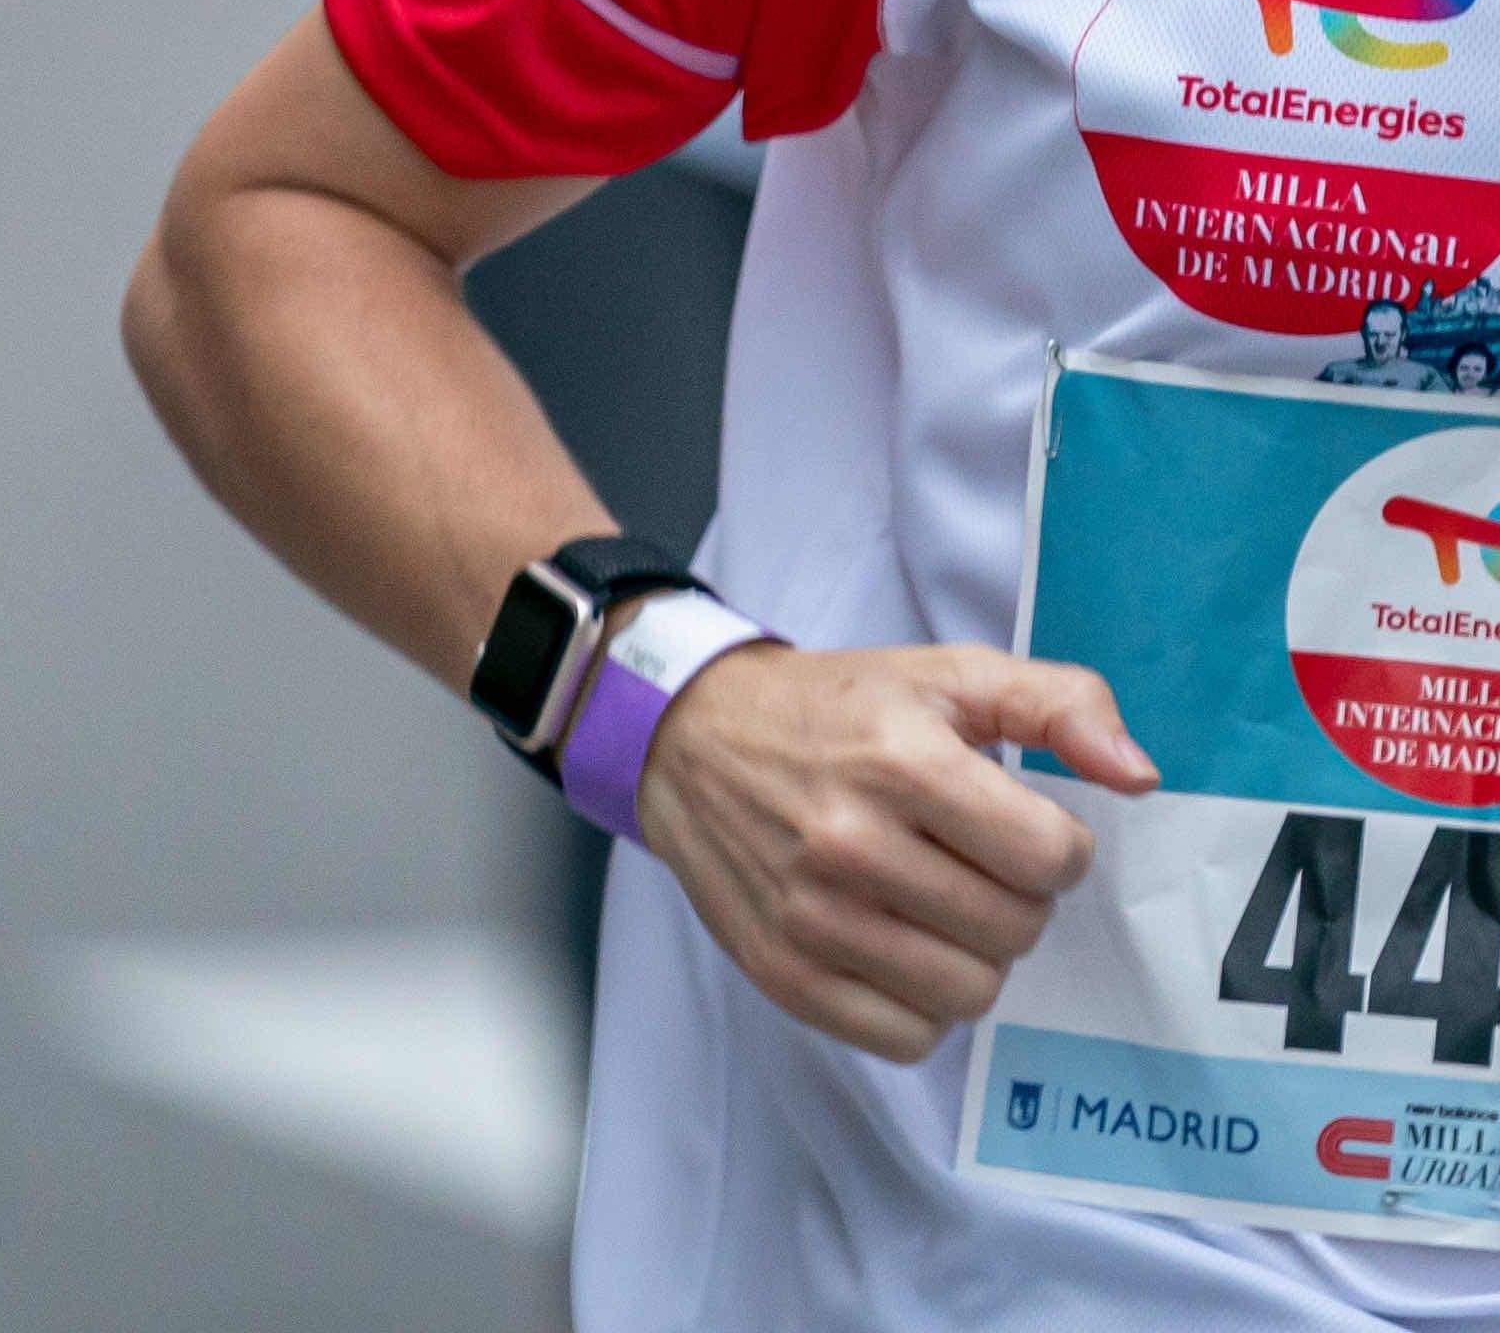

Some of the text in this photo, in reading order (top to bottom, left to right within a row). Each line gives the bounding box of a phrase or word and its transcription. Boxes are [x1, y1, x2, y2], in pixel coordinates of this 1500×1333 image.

[1177, 74, 1467, 141] TotalEnergies
[1233, 168, 1368, 214] MILLA
[1175, 245, 1412, 302] DE MADRID
[1371, 737, 1419, 767] DE
[1072, 1092, 1260, 1155] MADRID
